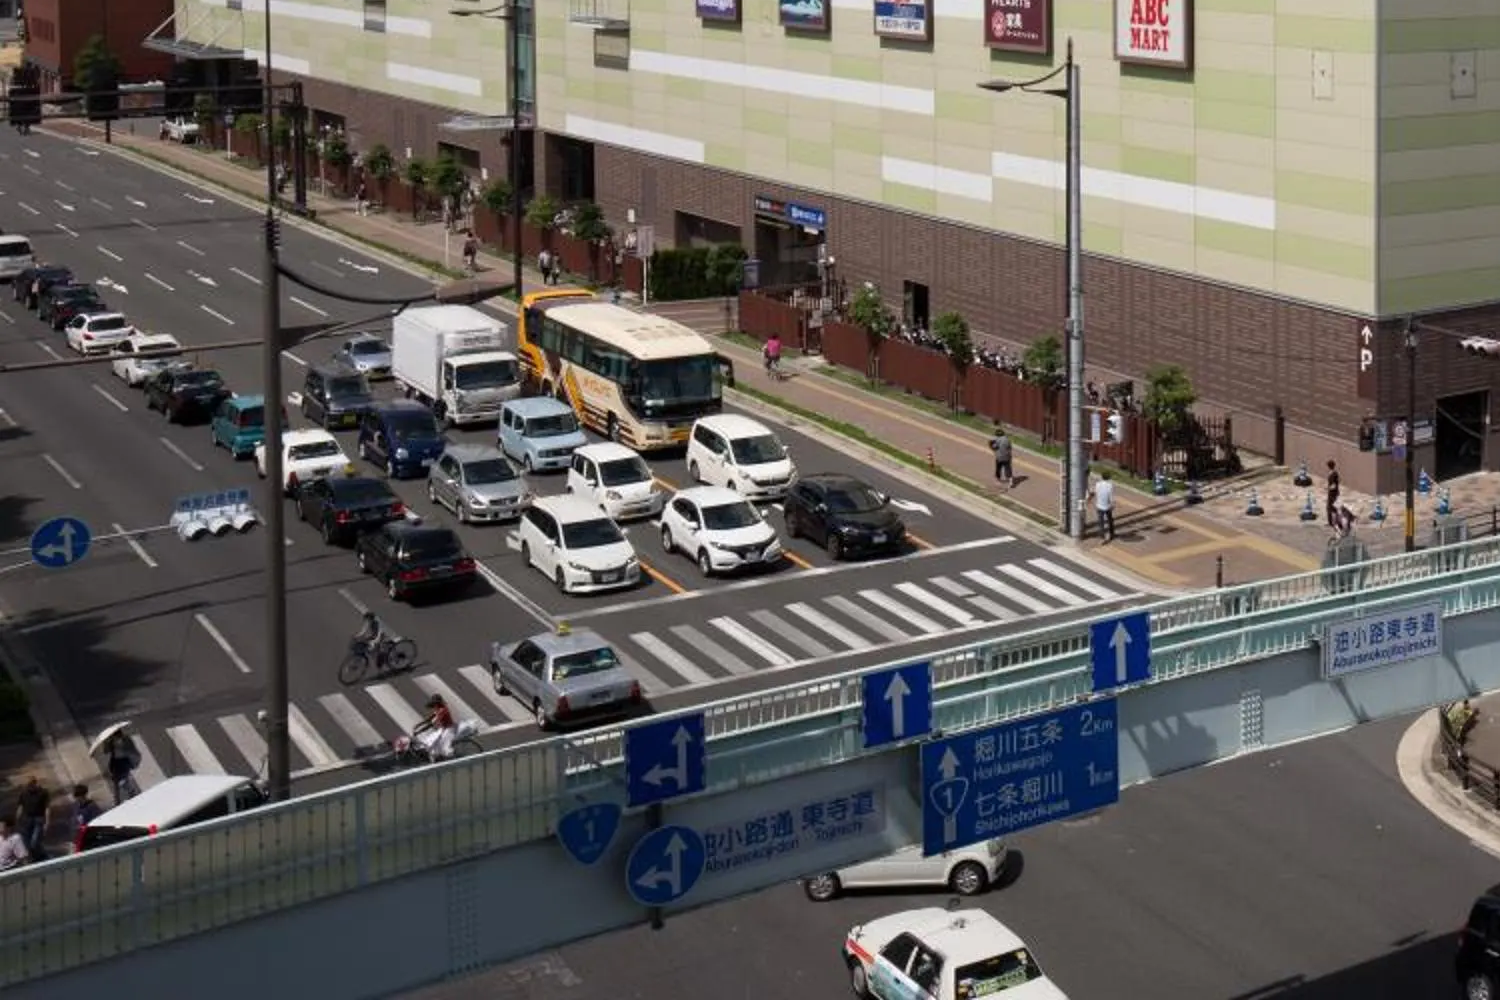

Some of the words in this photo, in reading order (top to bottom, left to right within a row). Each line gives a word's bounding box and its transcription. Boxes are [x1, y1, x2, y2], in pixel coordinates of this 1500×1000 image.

[1130, 28, 1170, 52] MART
[1361, 348, 1373, 372] P
[975, 717, 1064, 763] 堀川五条
[802, 789, 877, 831] 東寺道
[943, 787, 953, 808] 1
[975, 769, 1064, 818] 七条堀川
